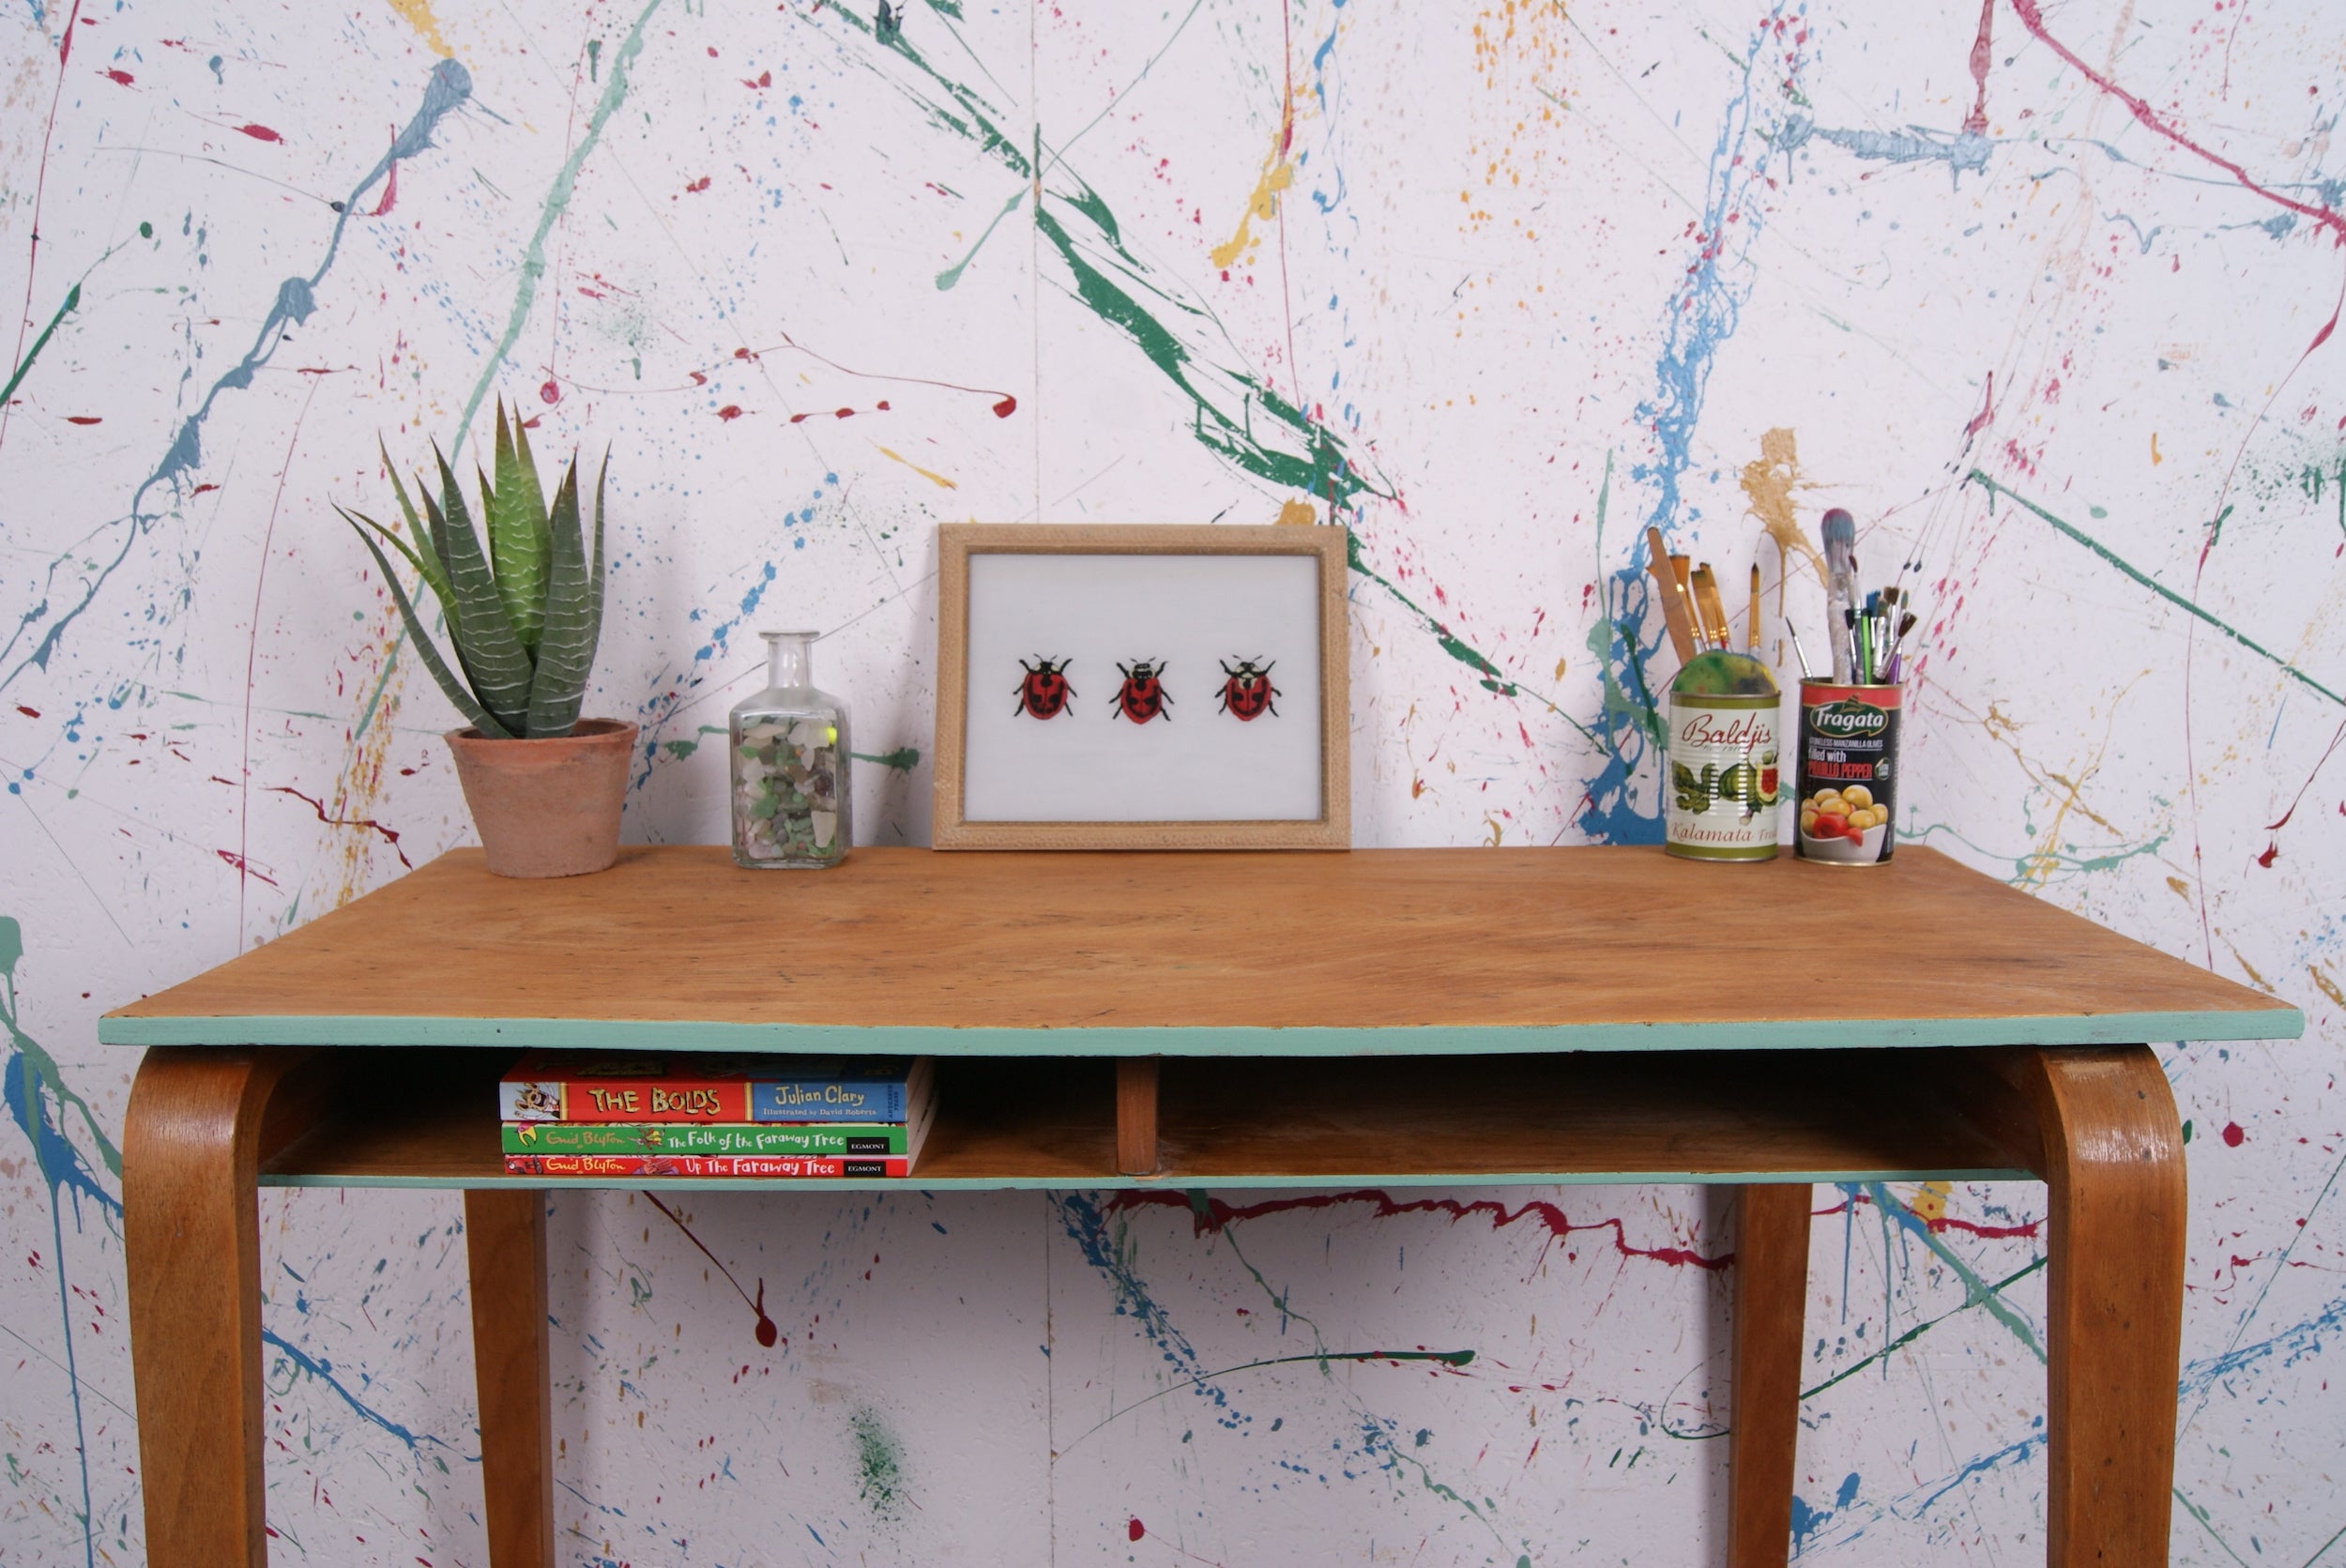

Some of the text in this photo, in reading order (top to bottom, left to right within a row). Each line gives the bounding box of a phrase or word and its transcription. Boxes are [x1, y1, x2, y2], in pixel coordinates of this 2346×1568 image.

[1815, 704, 1884, 732] Fragata
[1826, 750, 1847, 763] with
[1840, 762, 1873, 780] PEPPER
[1671, 822, 1752, 843] Kalamata
[587, 1087, 722, 1116] THE BOLDS
[775, 1084, 865, 1106] Julian Clary
[763, 1108, 807, 1117] Illustrated
[819, 1108, 843, 1117] David
[845, 1108, 877, 1117] Roberts
[545, 1131, 626, 1147] Enid Blyton
[667, 1130, 845, 1150] The Folk of the Faraway Tree
[851, 1142, 885, 1150] EGMONT
[545, 1157, 626, 1173] Enid Blyton
[685, 1158, 836, 1176] Up The Faraway Tree
[847, 1165, 882, 1173] EGMONT
